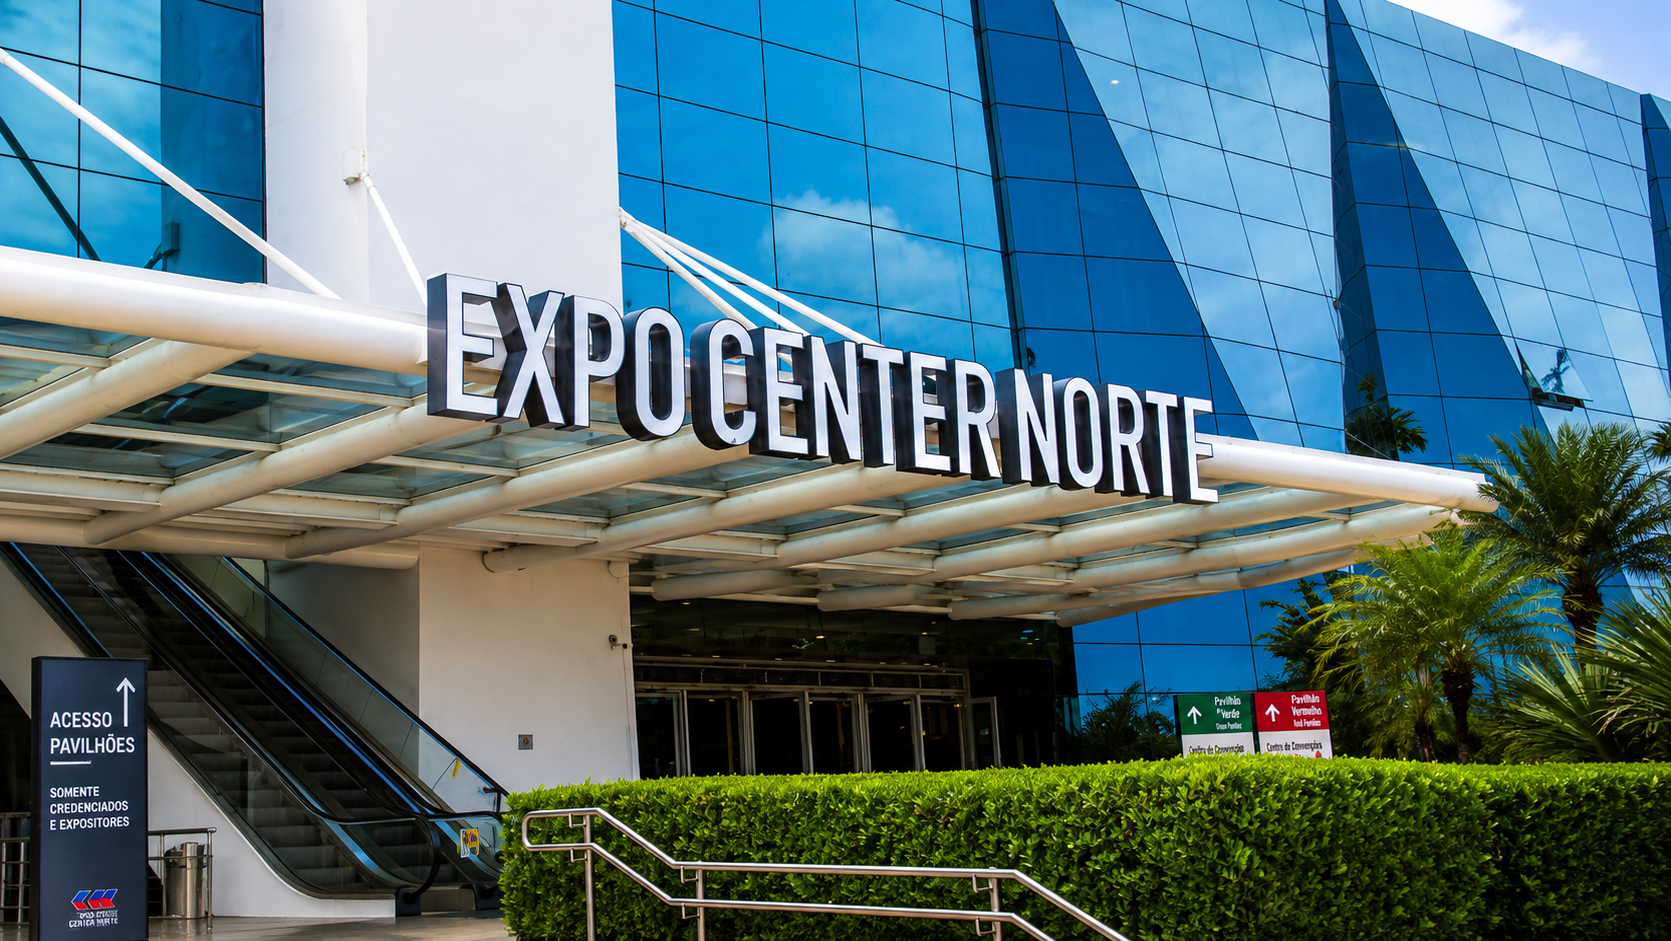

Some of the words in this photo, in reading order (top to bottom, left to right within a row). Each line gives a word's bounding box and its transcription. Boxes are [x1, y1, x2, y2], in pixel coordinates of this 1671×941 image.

[432, 274, 685, 438] EXPO
[700, 319, 1001, 479] CENTER
[1010, 368, 1219, 504] NORTE
[50, 712, 112, 728] ACESSO
[50, 734, 135, 754] PAVILHÕES
[50, 786, 100, 798] SOMENTE
[50, 801, 129, 814] CREDENCIADOS
[50, 820, 57, 830] E
[59, 817, 130, 830] EXPOSITORES
